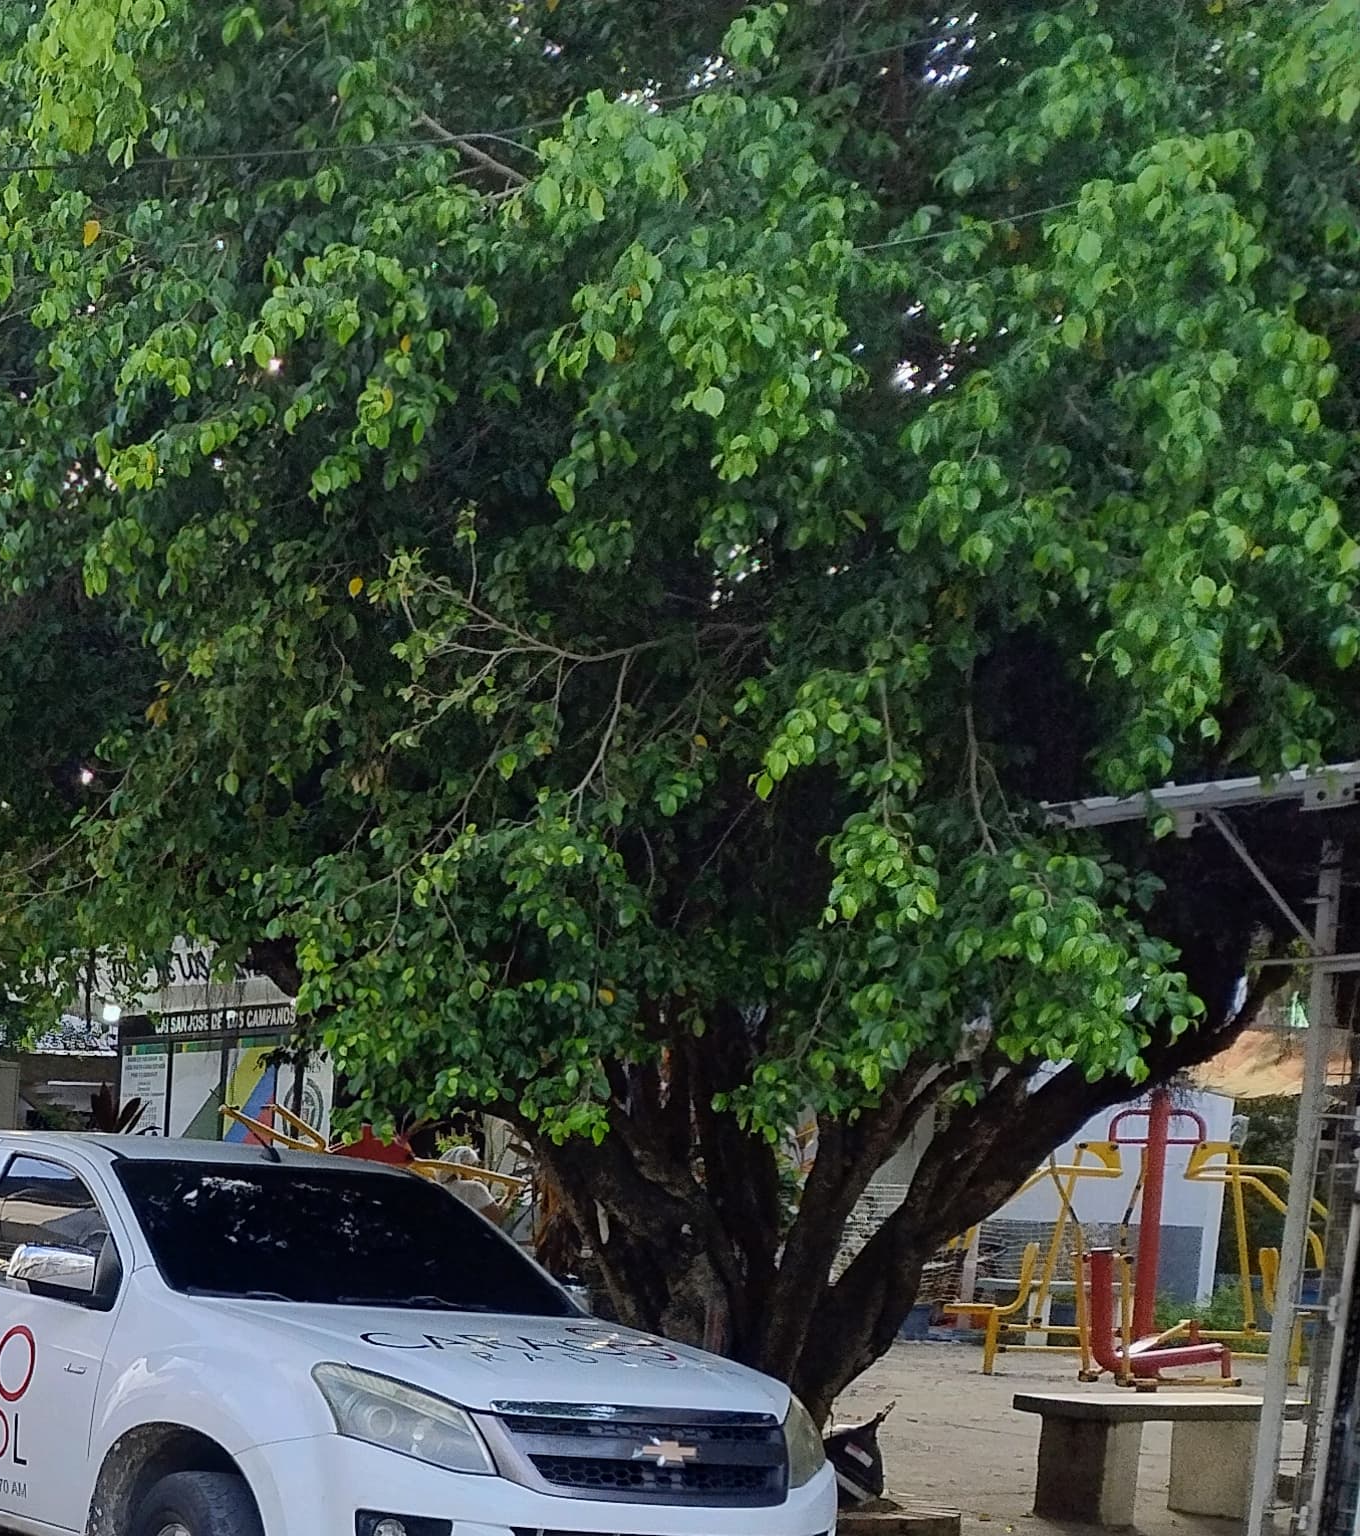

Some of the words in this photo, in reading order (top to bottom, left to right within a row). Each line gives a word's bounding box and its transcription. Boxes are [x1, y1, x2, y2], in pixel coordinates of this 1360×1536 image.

[170, 1015, 188, 1033] SAN
[187, 1013, 209, 1032] JOSE
[211, 1011, 223, 1030] DE
[246, 1006, 296, 1028] CAMPANOS
[11, 1482, 28, 1498] AM
